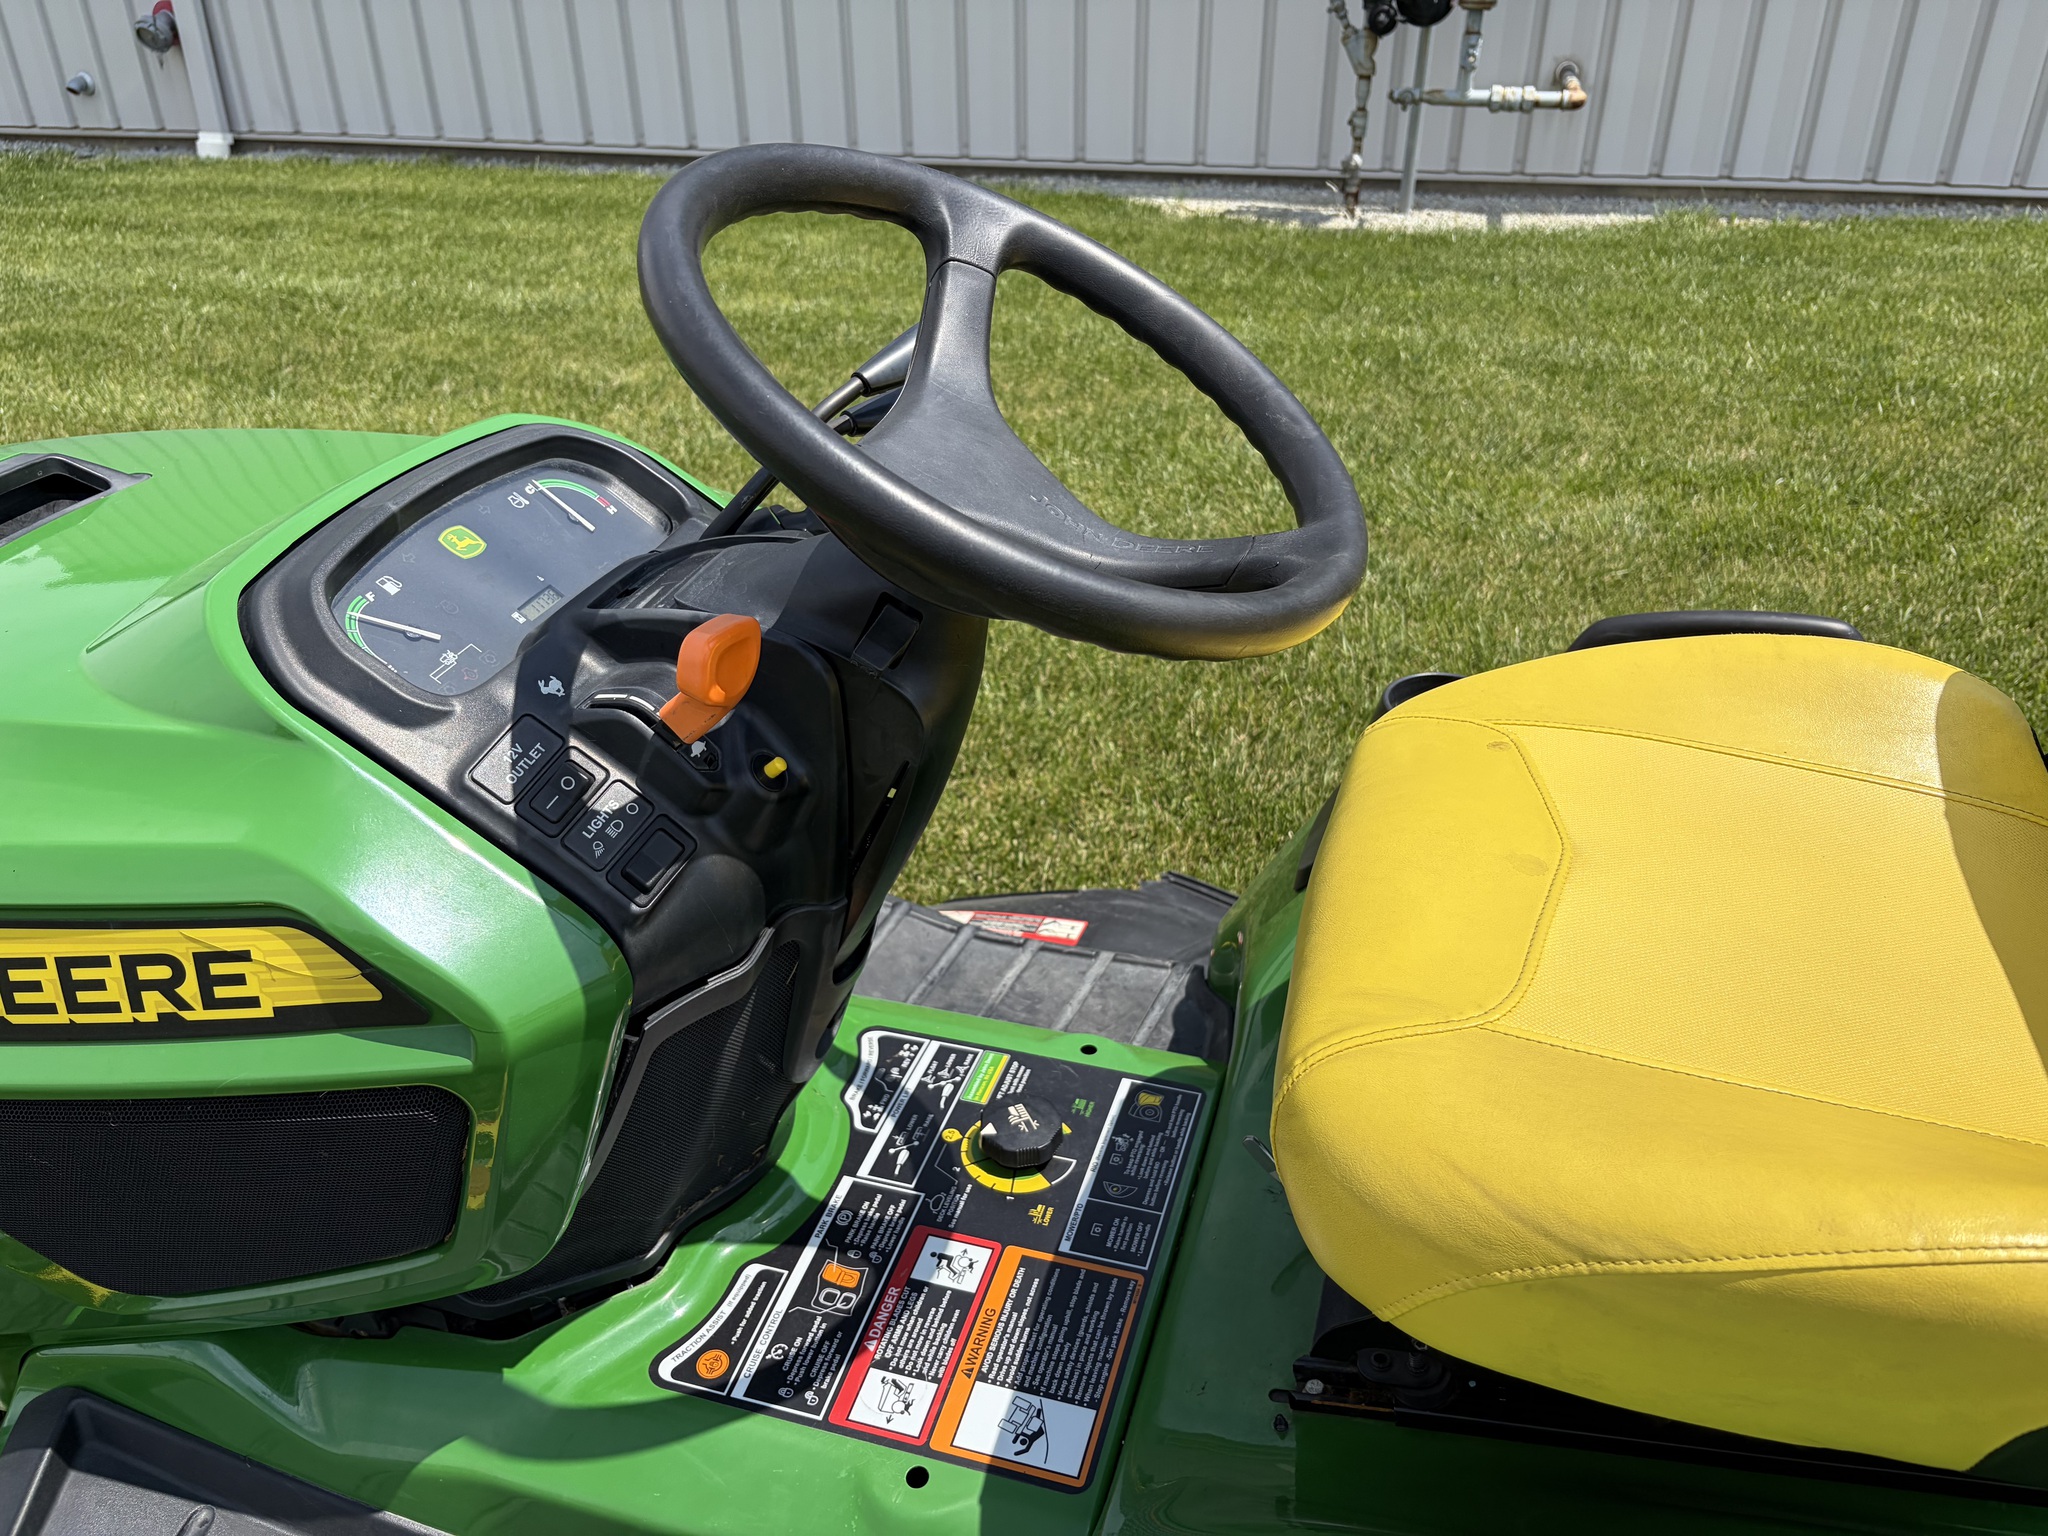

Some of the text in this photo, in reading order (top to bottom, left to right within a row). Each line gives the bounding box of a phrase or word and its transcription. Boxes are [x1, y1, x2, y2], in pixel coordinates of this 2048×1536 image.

[525, 484, 535, 494] C
[606, 505, 617, 515] H
[1030, 495, 1216, 554] JOHN DEERE
[365, 591, 375, 602] F
[503, 743, 523, 764] 12V
[506, 742, 546, 784] OUTLET
[582, 799, 620, 839] LIGHTS
[900, 1057, 910, 1067] REV
[927, 1060, 937, 1073] FLOAT
[945, 1053, 956, 1067] LOWER
[963, 1053, 973, 1065] RAISE
[906, 1114, 917, 1130] LOWER
[922, 1113, 934, 1126] RAISE
[945, 1130, 955, 1139] 2.5
[936, 1186, 956, 1222] DECK LEVELING
[947, 1193, 960, 1215] POSITION
[964, 1183, 972, 1192] use
[814, 1194, 841, 1238] PARK BRAKE
[844, 1201, 869, 1243] PARK BRAKE ON
[870, 1204, 896, 1249] PARK BRAKE OFF
[948, 1218, 957, 1228] See
[952, 1200, 964, 1217] manual
[1042, 1206, 1053, 1225] LOWER
[1064, 1203, 1083, 1241] MOWER/PTO
[1105, 1217, 1120, 1247] MOWER ON
[1130, 1221, 1144, 1252] MOWER OFF
[1024, 1296, 1032, 1306] not
[1029, 1278, 1039, 1296] across
[731, 1281, 766, 1341] Push for added traction
[869, 1287, 899, 1337] DANGER
[874, 1286, 910, 1359] ROTATING BLADES CUT
[884, 1292, 917, 1358] OFF ARMS AND LEGS
[889, 1357, 898, 1366] Do
[894, 1346, 903, 1356] not
[899, 1331, 908, 1346] mow
[905, 1315, 916, 1331] when
[912, 1293, 925, 1315] children
[913, 1290, 951, 1372] Look down and behind before
[981, 1267, 1025, 1372] AVOID SERIOUS INJURY OR DEATH
[1014, 1371, 1023, 1384] Add
[1019, 1352, 1031, 1371] proper
[1026, 1331, 1037, 1351] ballast
[1037, 1296, 1051, 1322] operating
[1047, 1268, 1060, 1295] conditions
[671, 1333, 706, 1362] TRACTION
[706, 1310, 726, 1334] ASSIST
[743, 1310, 782, 1378] CRUISE CONTROL
[782, 1336, 803, 1370] CRUISE ON
[787, 1315, 823, 1380] Depress forward pedal
[898, 1317, 923, 1368] others are around
[905, 1361, 913, 1370] Do
[910, 1349, 918, 1360] not
[914, 1335, 924, 1349] mow
[923, 1307, 936, 1328] reverse
[921, 1322, 947, 1374] and while backing
[928, 1309, 960, 1376] Never carry children even
[965, 1308, 995, 1365] WARNING
[988, 1311, 1017, 1378] Read operator's manual
[1005, 1327, 1030, 1383] Avoid sudden turns
[1006, 1343, 1015, 1355] and
[1011, 1327, 1021, 1343] down
[1023, 1314, 1054, 1387] and machine configuration
[1032, 1323, 1058, 1385] See operator's manual
[1057, 1379, 1067, 1395] Keep
[1063, 1360, 1075, 1379] safety
[1069, 1338, 1080, 1360] devices
[1085, 1293, 1095, 1313] shields
[1091, 1282, 1099, 1293] and
[1078, 1345, 1088, 1361] place
[1087, 1310, 1099, 1332] working
[794, 1366, 806, 1382] Push
[802, 1348, 814, 1365] lower
[811, 1329, 823, 1347] button
[809, 1340, 831, 1377] CRUISE OFF
[812, 1362, 828, 1387] Depress
[824, 1338, 839, 1361] forward
[820, 1354, 842, 1388] brake pedal
[936, 1337, 957, 1378] with blades off
[997, 1365, 1007, 1380] Drive
[1004, 1356, 1012, 1364] up
[1083, 1384, 1093, 1401] When
[1089, 1361, 1101, 1383] leaving
